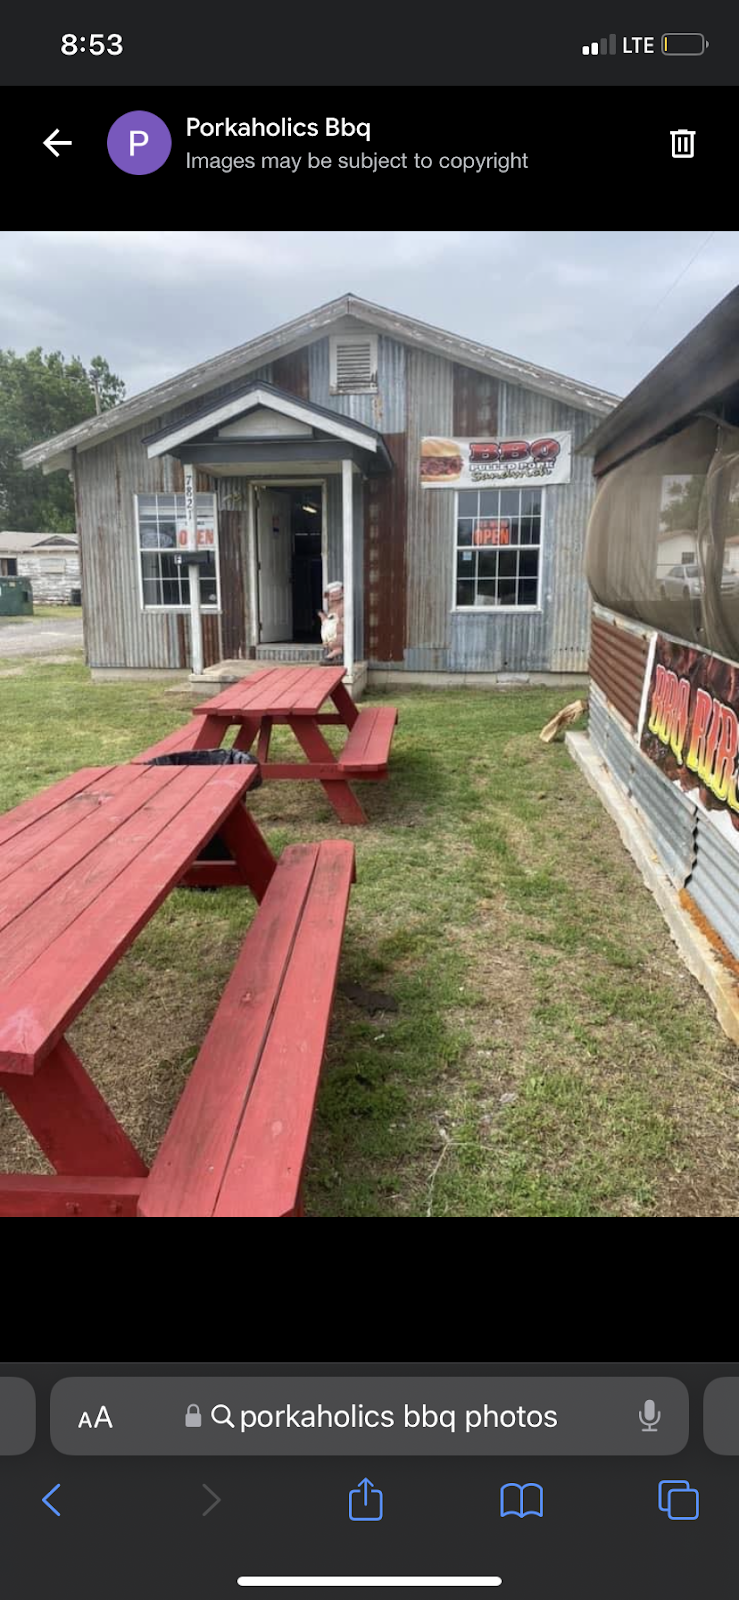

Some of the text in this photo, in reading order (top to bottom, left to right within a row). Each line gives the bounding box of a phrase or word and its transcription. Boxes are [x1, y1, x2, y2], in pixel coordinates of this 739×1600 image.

[470, 439, 560, 463] BBQ
[470, 461, 555, 471] PULLED PORK
[471, 467, 553, 482] Sandwich
[180, 529, 214, 545] OEN
[475, 528, 508, 544] OPEN
[648, 664, 691, 766] BBQ
